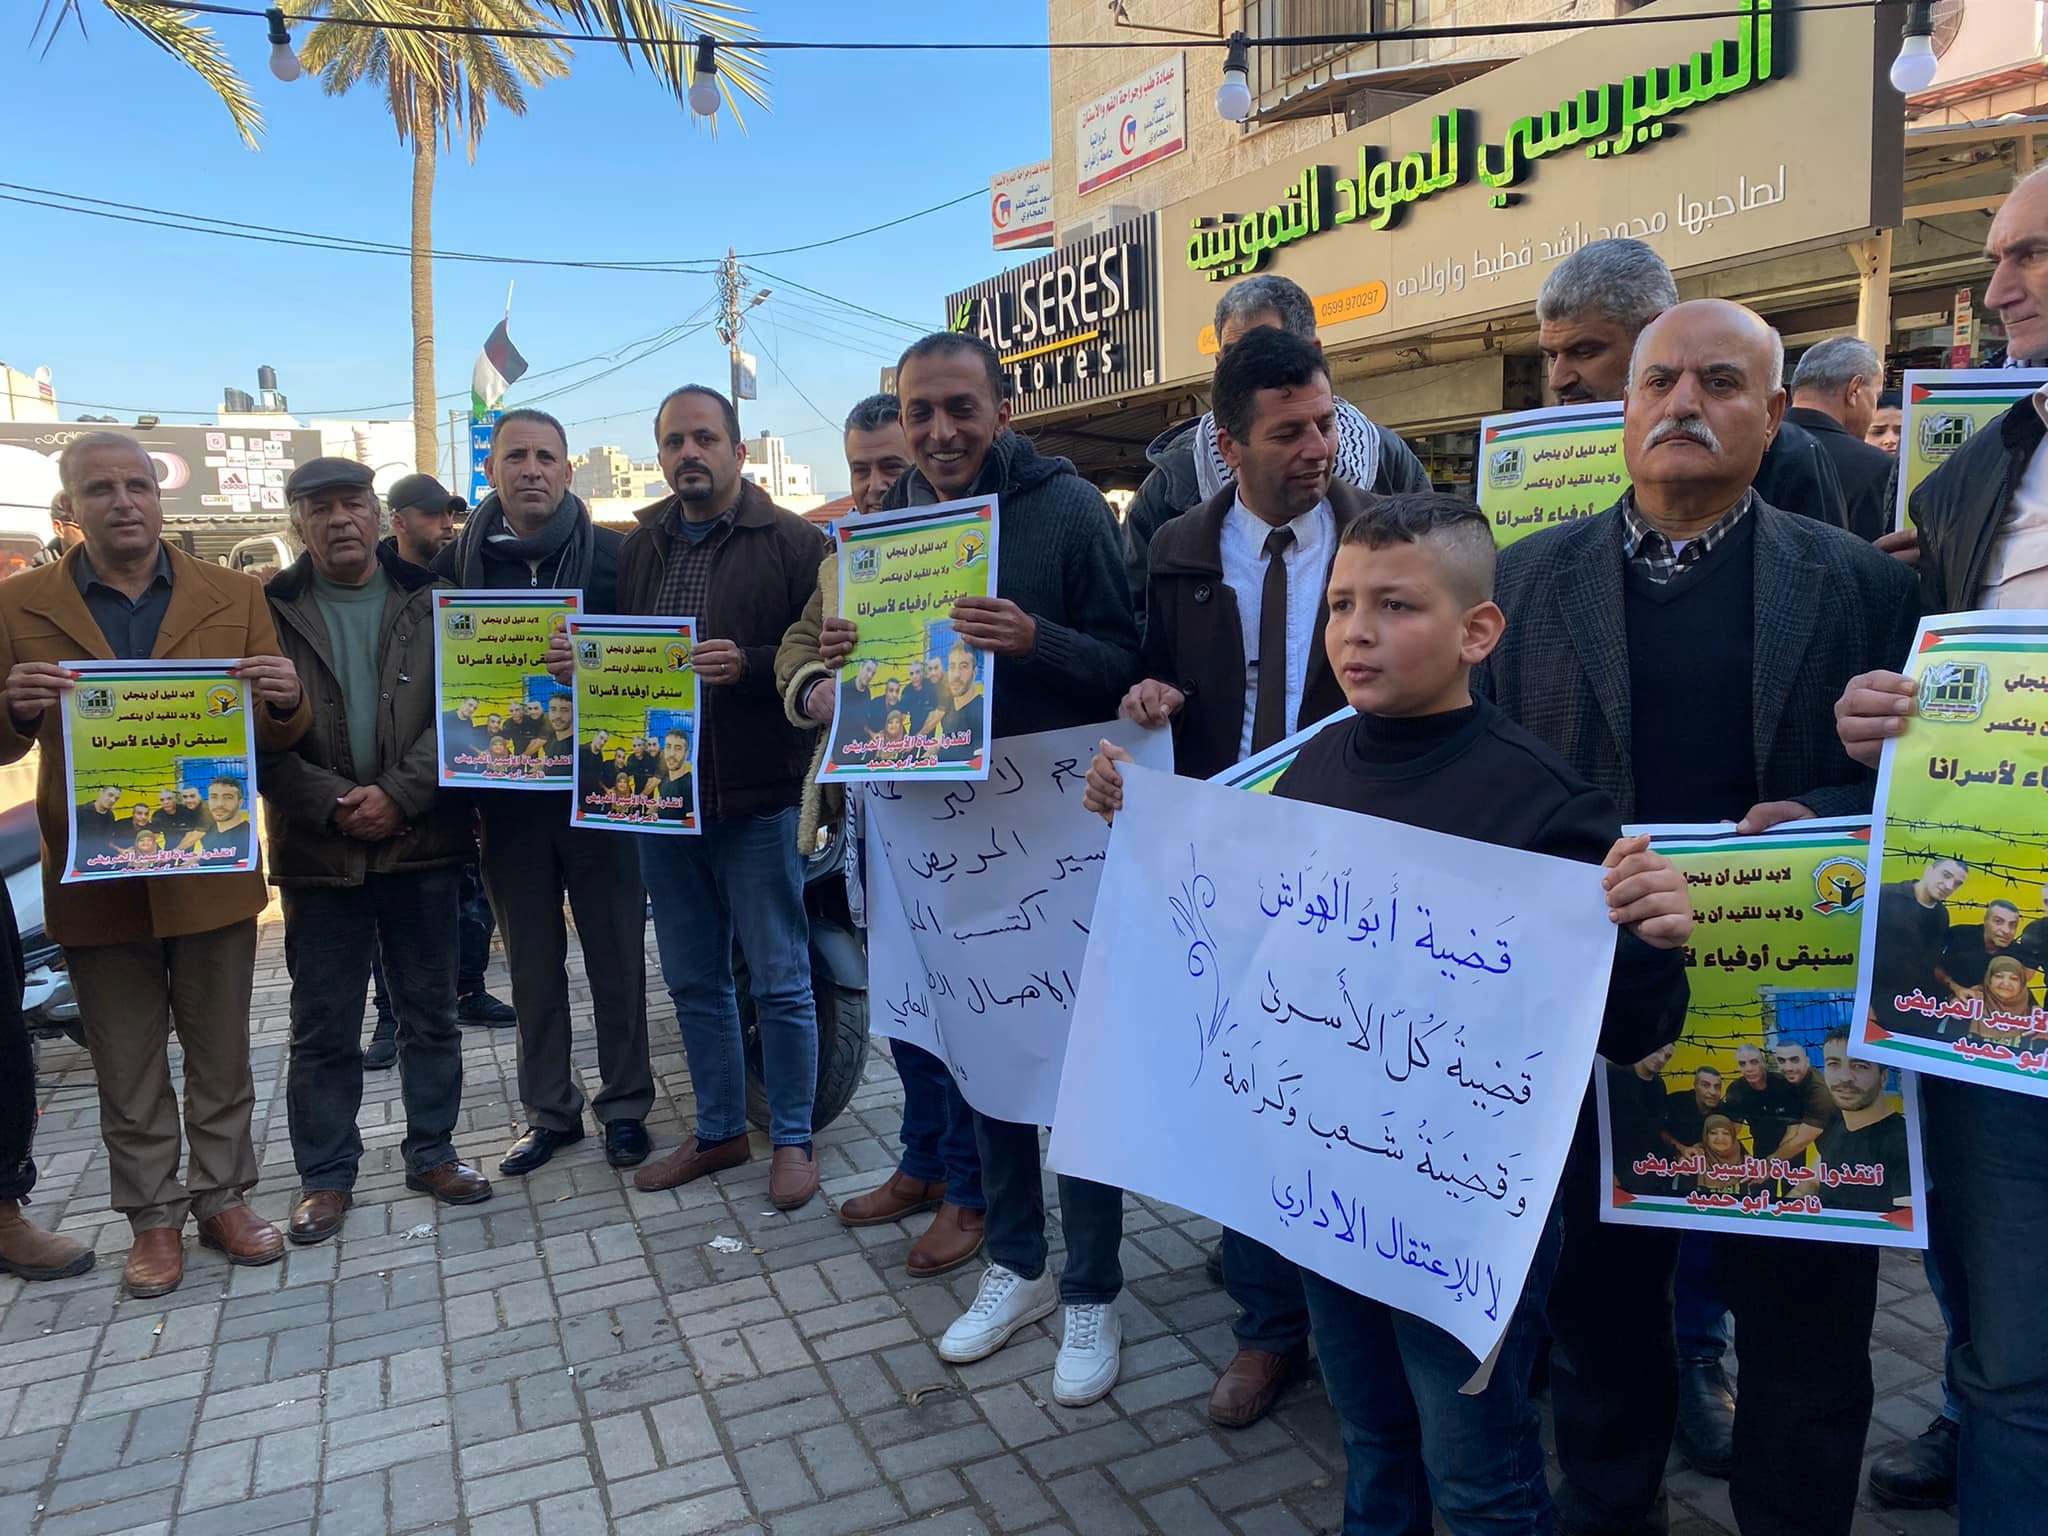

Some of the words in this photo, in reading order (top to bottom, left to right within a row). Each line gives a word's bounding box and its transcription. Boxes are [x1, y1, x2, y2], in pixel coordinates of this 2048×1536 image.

[1477, 0, 1772, 208] السيريسي
[1335, 107, 1458, 231] للمواد
[1678, 165, 1787, 235] لصاحبها
[1186, 164, 1320, 283] التموينية
[979, 242, 1129, 350] AL-SERESI
[1015, 342, 1112, 395] tores
[1983, 717, 2036, 736] ينكسر
[1928, 757, 2016, 787] لأسرانا
[1051, 849, 1106, 880] سير
[1715, 868, 1730, 885] أن
[1733, 868, 1762, 885] لليل
[1765, 867, 1791, 884] لابد
[1708, 905, 1723, 923] أن
[1726, 906, 1762, 923] للقيد
[1765, 908, 1781, 921] بد
[1784, 905, 1803, 921] ولا
[1703, 944, 1769, 972] أوفياء
[1776, 945, 1853, 972] سنبقى
[1894, 988, 1984, 1020] المريض
[1952, 1037, 2015, 1061] حميد
[1632, 1153, 1706, 1176] المريض
[1708, 1156, 1767, 1181] الأسير
[1770, 1159, 1815, 1182] حياة
[1820, 1162, 1885, 1187] أنقذوا
[1686, 1190, 1737, 1211] حميد
[1740, 1190, 1770, 1214] أبو
[1771, 1196, 1821, 1216] ناصر
[1484, 1263, 1501, 1322] لا
